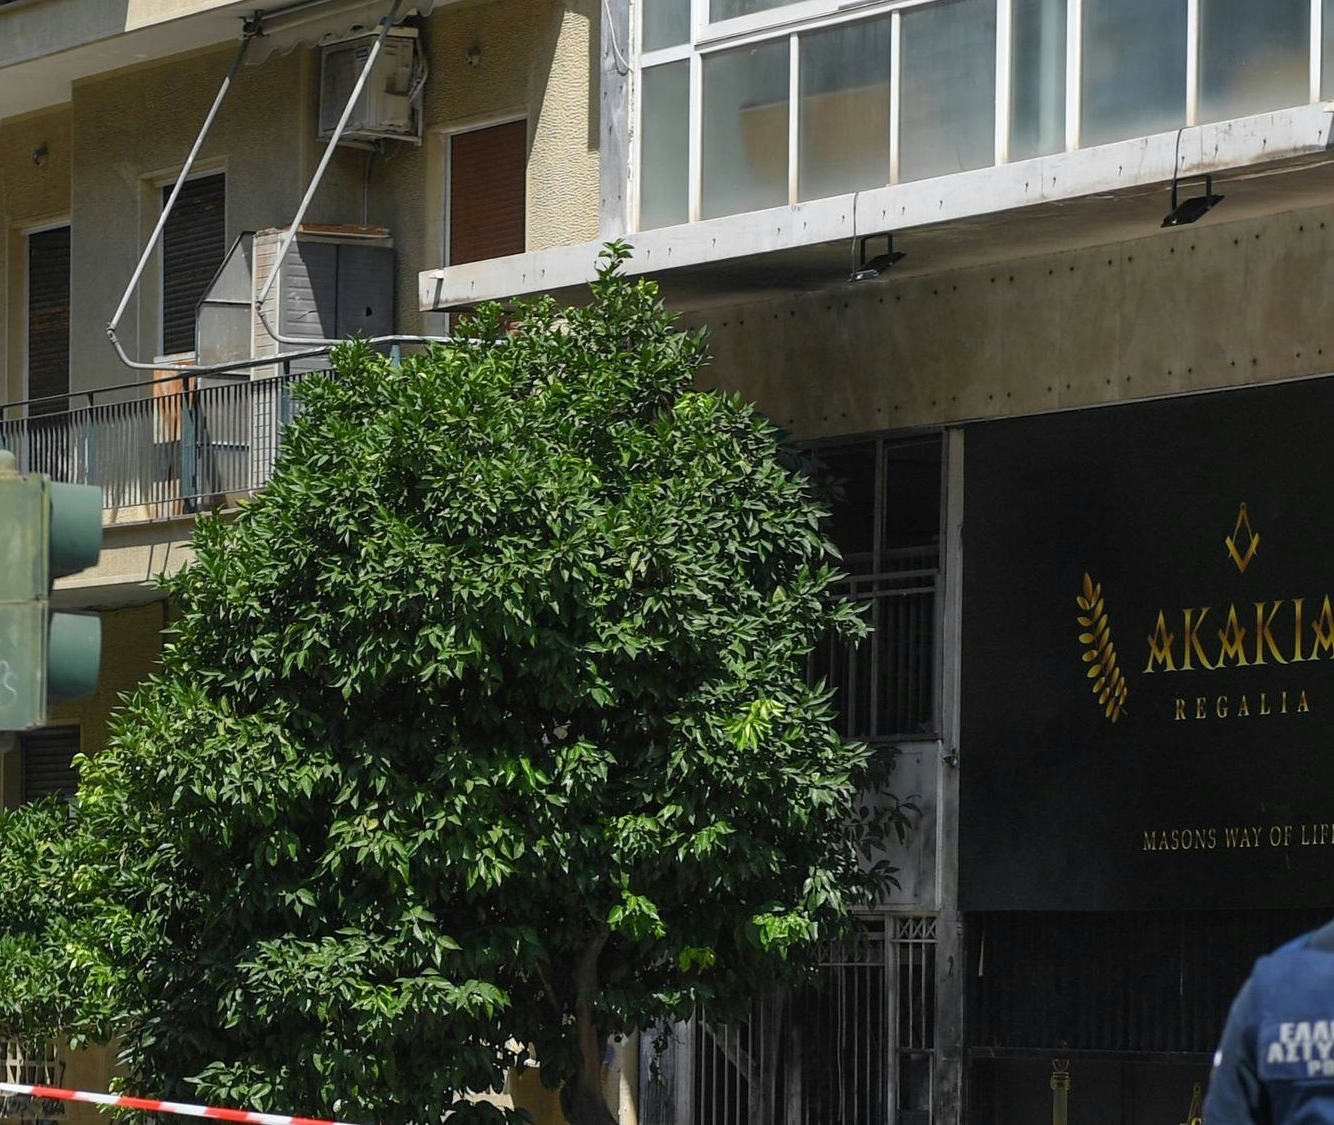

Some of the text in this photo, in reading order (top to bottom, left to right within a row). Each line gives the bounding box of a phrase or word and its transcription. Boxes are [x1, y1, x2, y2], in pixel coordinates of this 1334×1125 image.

[1173, 689, 1310, 721] REGALIA
[1143, 828, 1217, 851] MASONS
[1225, 826, 1262, 848] WAY
[1269, 825, 1292, 847] OF
